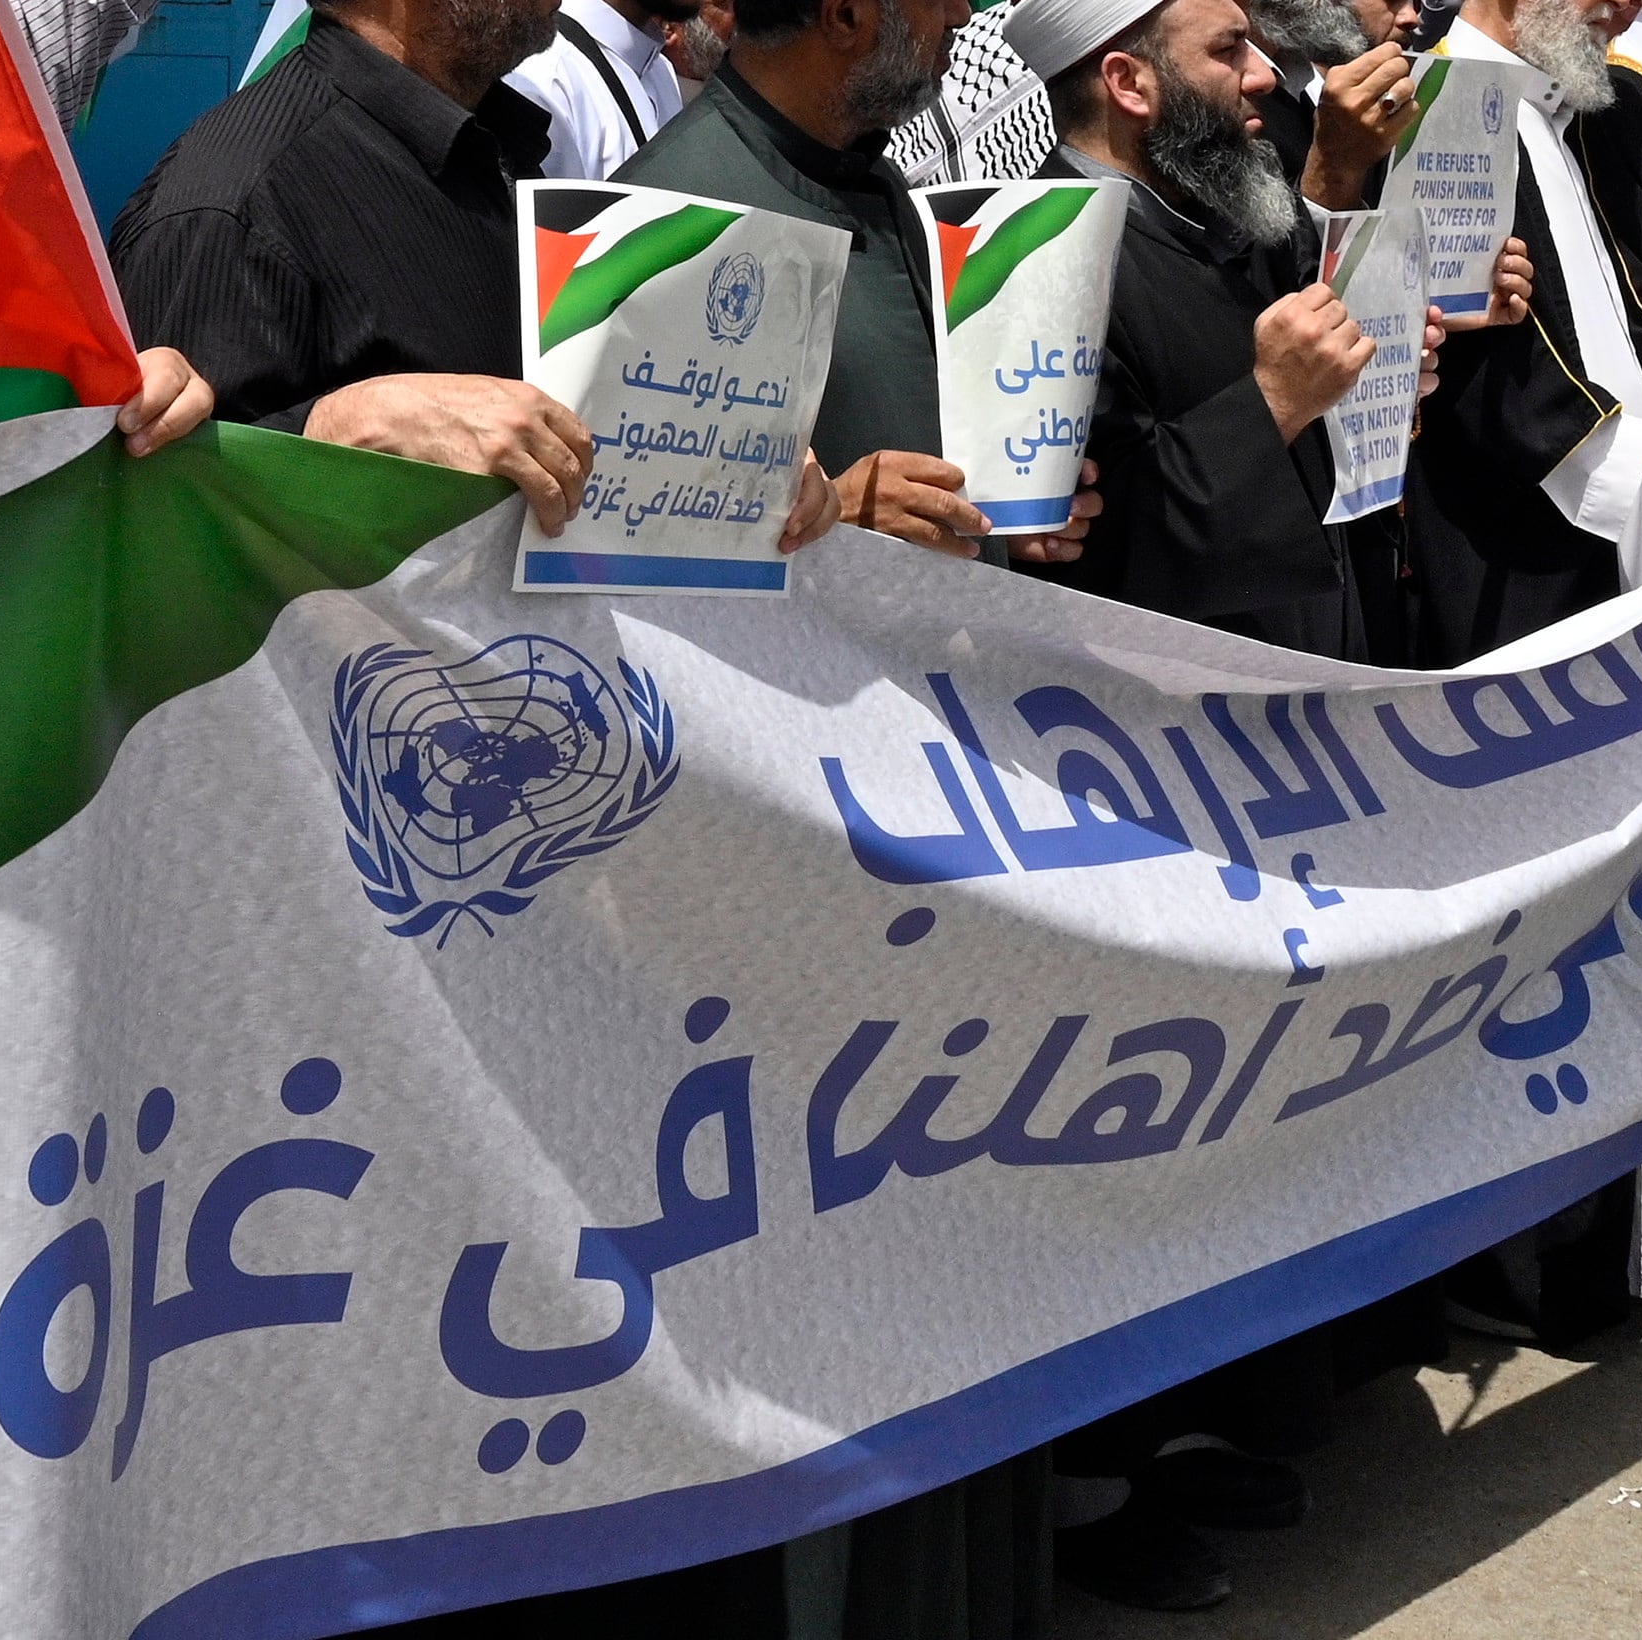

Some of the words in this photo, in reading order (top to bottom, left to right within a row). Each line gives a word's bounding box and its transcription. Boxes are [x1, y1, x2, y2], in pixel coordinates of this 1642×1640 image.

[1416, 151, 1433, 172] WE
[1435, 152, 1475, 174] REFUSE
[1477, 154, 1491, 173] TO
[1412, 179, 1456, 200] PUNISH
[1457, 181, 1495, 201] UNRWA
[1474, 208, 1497, 227] FOR
[1437, 234, 1491, 253] NATIONAL
[1394, 313, 1407, 336] TO
[995, 339, 1065, 394] على
[1375, 342, 1412, 370] UNRWA
[621, 350, 724, 408] لوقف
[721, 375, 790, 412] ندعو
[1396, 371, 1417, 394] FOR
[1005, 405, 1091, 476] لوطني
[581, 473, 627, 521] غزة
[624, 481, 670, 537] في
[668, 479, 735, 521] أهلنا
[724, 491, 765, 524] ضد
[1272, 908, 1525, 1124] ضد
[809, 925, 1314, 1214] أهلنا
[438, 995, 759, 1476] في
